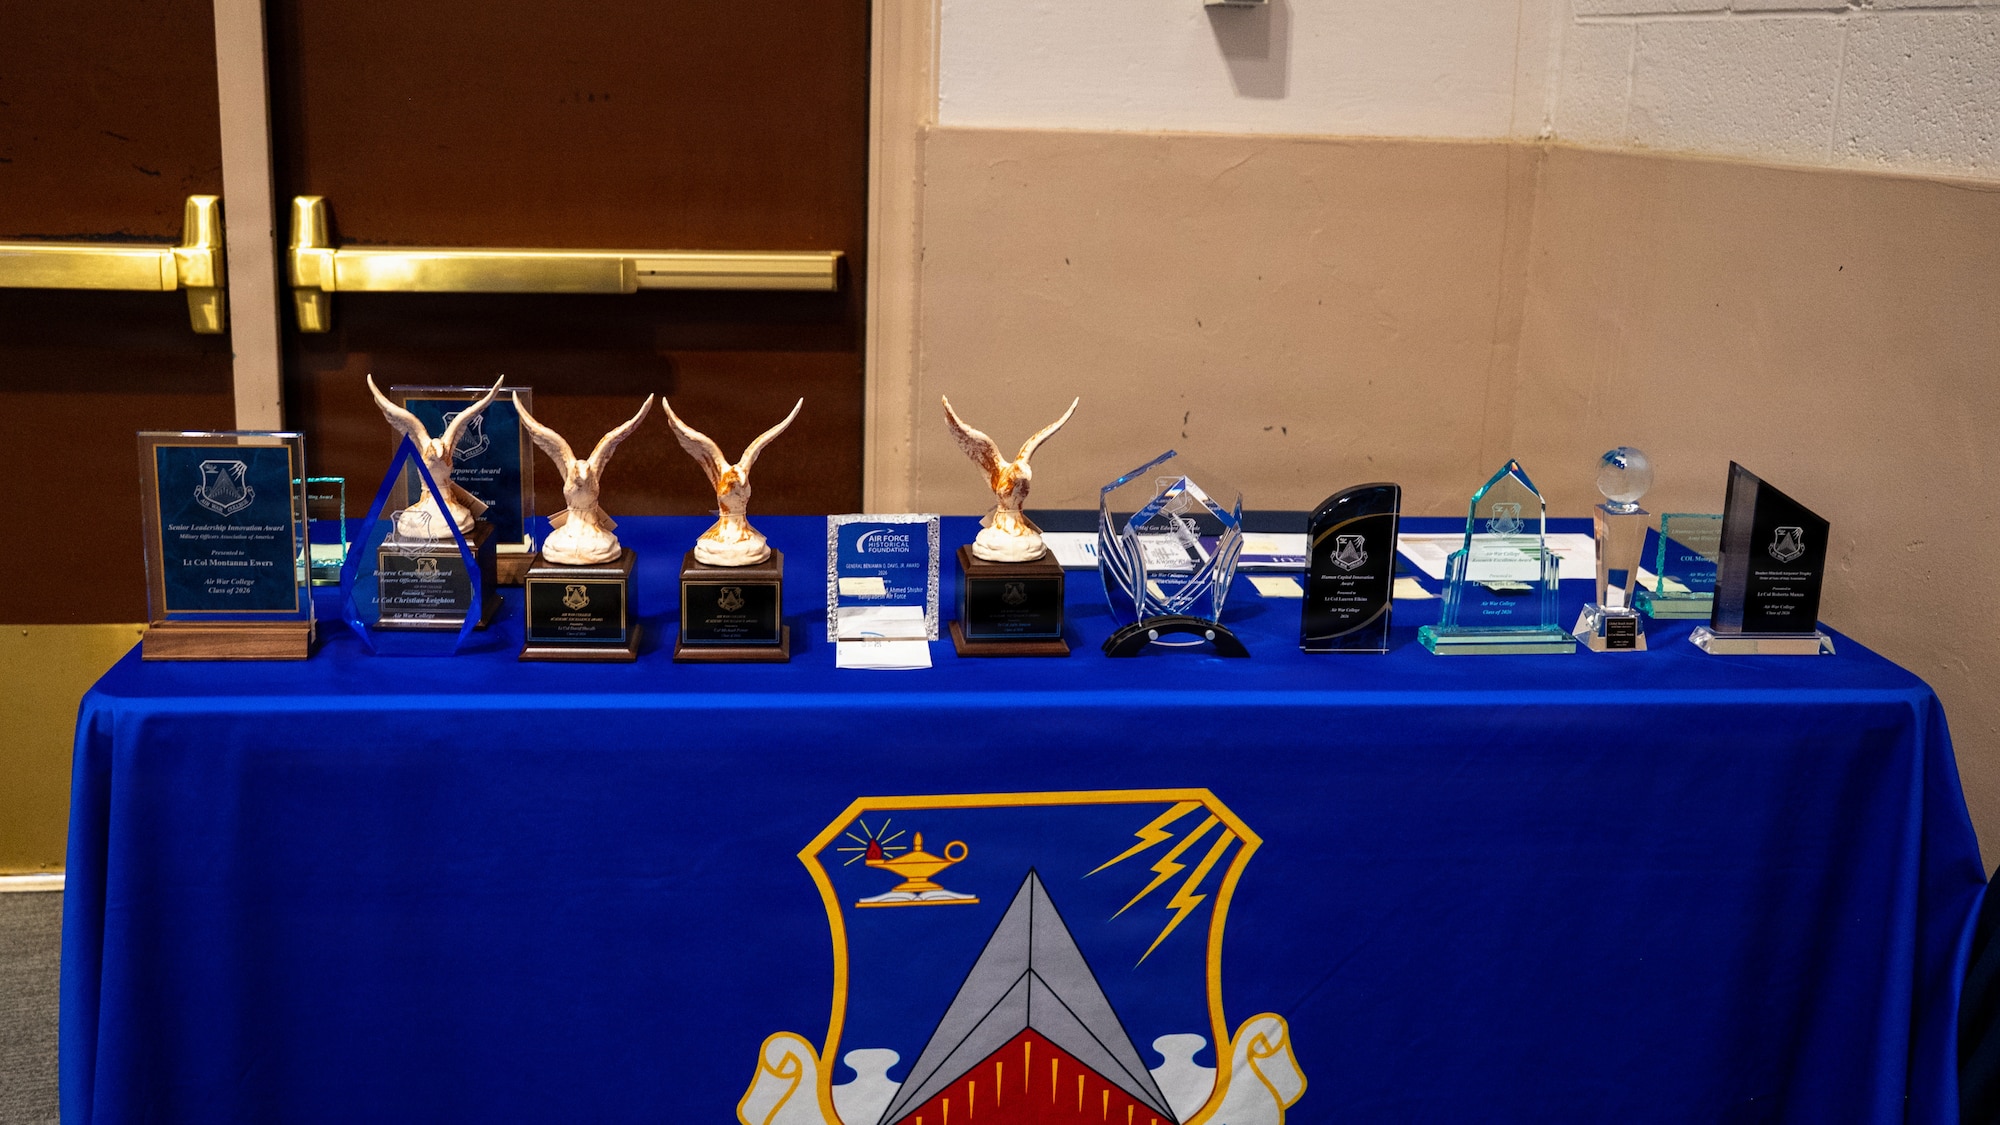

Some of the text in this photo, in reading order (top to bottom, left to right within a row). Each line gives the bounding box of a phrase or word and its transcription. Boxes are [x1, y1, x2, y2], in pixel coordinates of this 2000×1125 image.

[451, 467, 502, 477] irpower Award
[168, 523, 190, 531] Senior
[190, 523, 226, 533] Leadership
[263, 524, 285, 532] Award
[179, 533, 199, 541] Military
[199, 533, 219, 541] Officers
[193, 559, 208, 567] Col
[209, 559, 248, 567] Montanna
[249, 559, 274, 567] Ewers
[373, 570, 398, 578] Reserve
[398, 570, 432, 579] Component
[230, 578, 256, 587] College
[226, 587, 235, 595] of
[426, 597, 456, 606] Leighton
[414, 612, 436, 620] College
